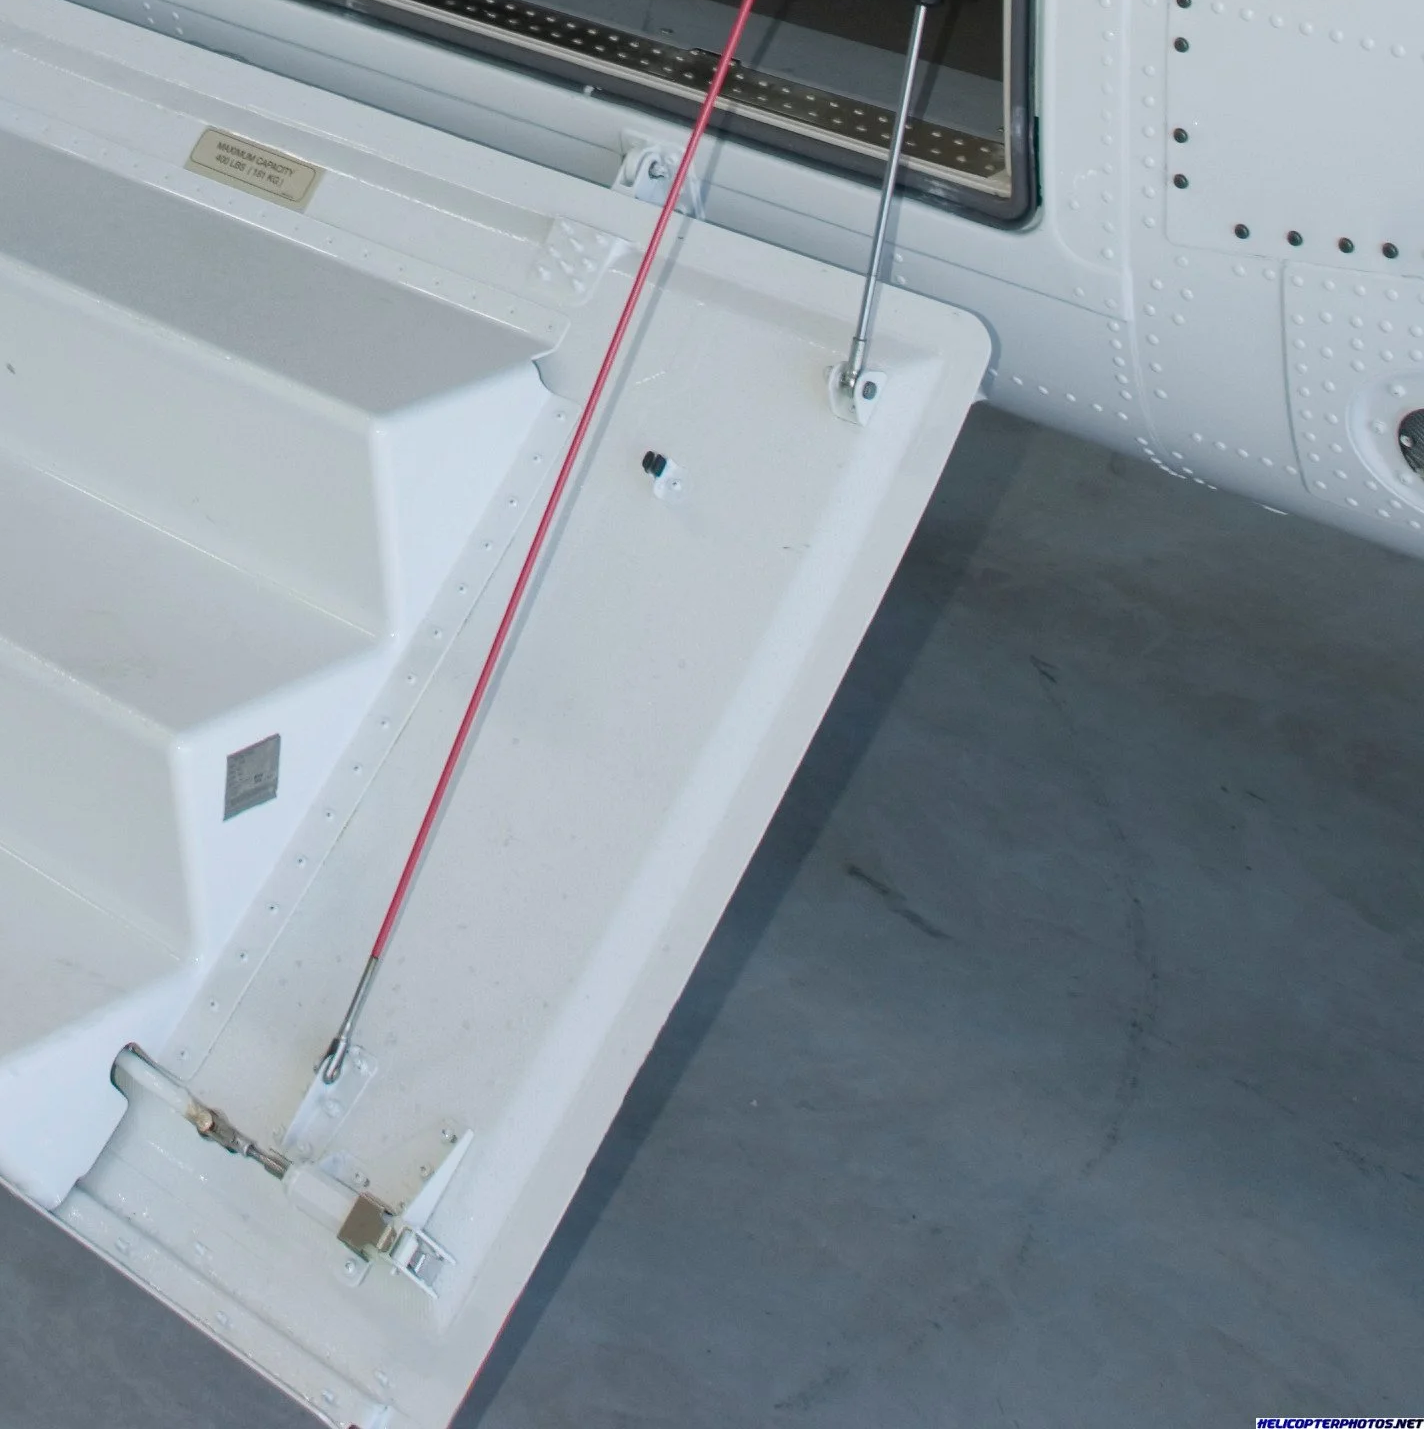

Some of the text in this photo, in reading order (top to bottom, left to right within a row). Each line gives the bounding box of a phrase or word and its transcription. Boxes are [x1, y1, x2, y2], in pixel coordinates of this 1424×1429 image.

[215, 154, 230, 165] 400
[229, 159, 247, 172] LBS
[216, 142, 296, 178] MAXIMUM CAPACITY
